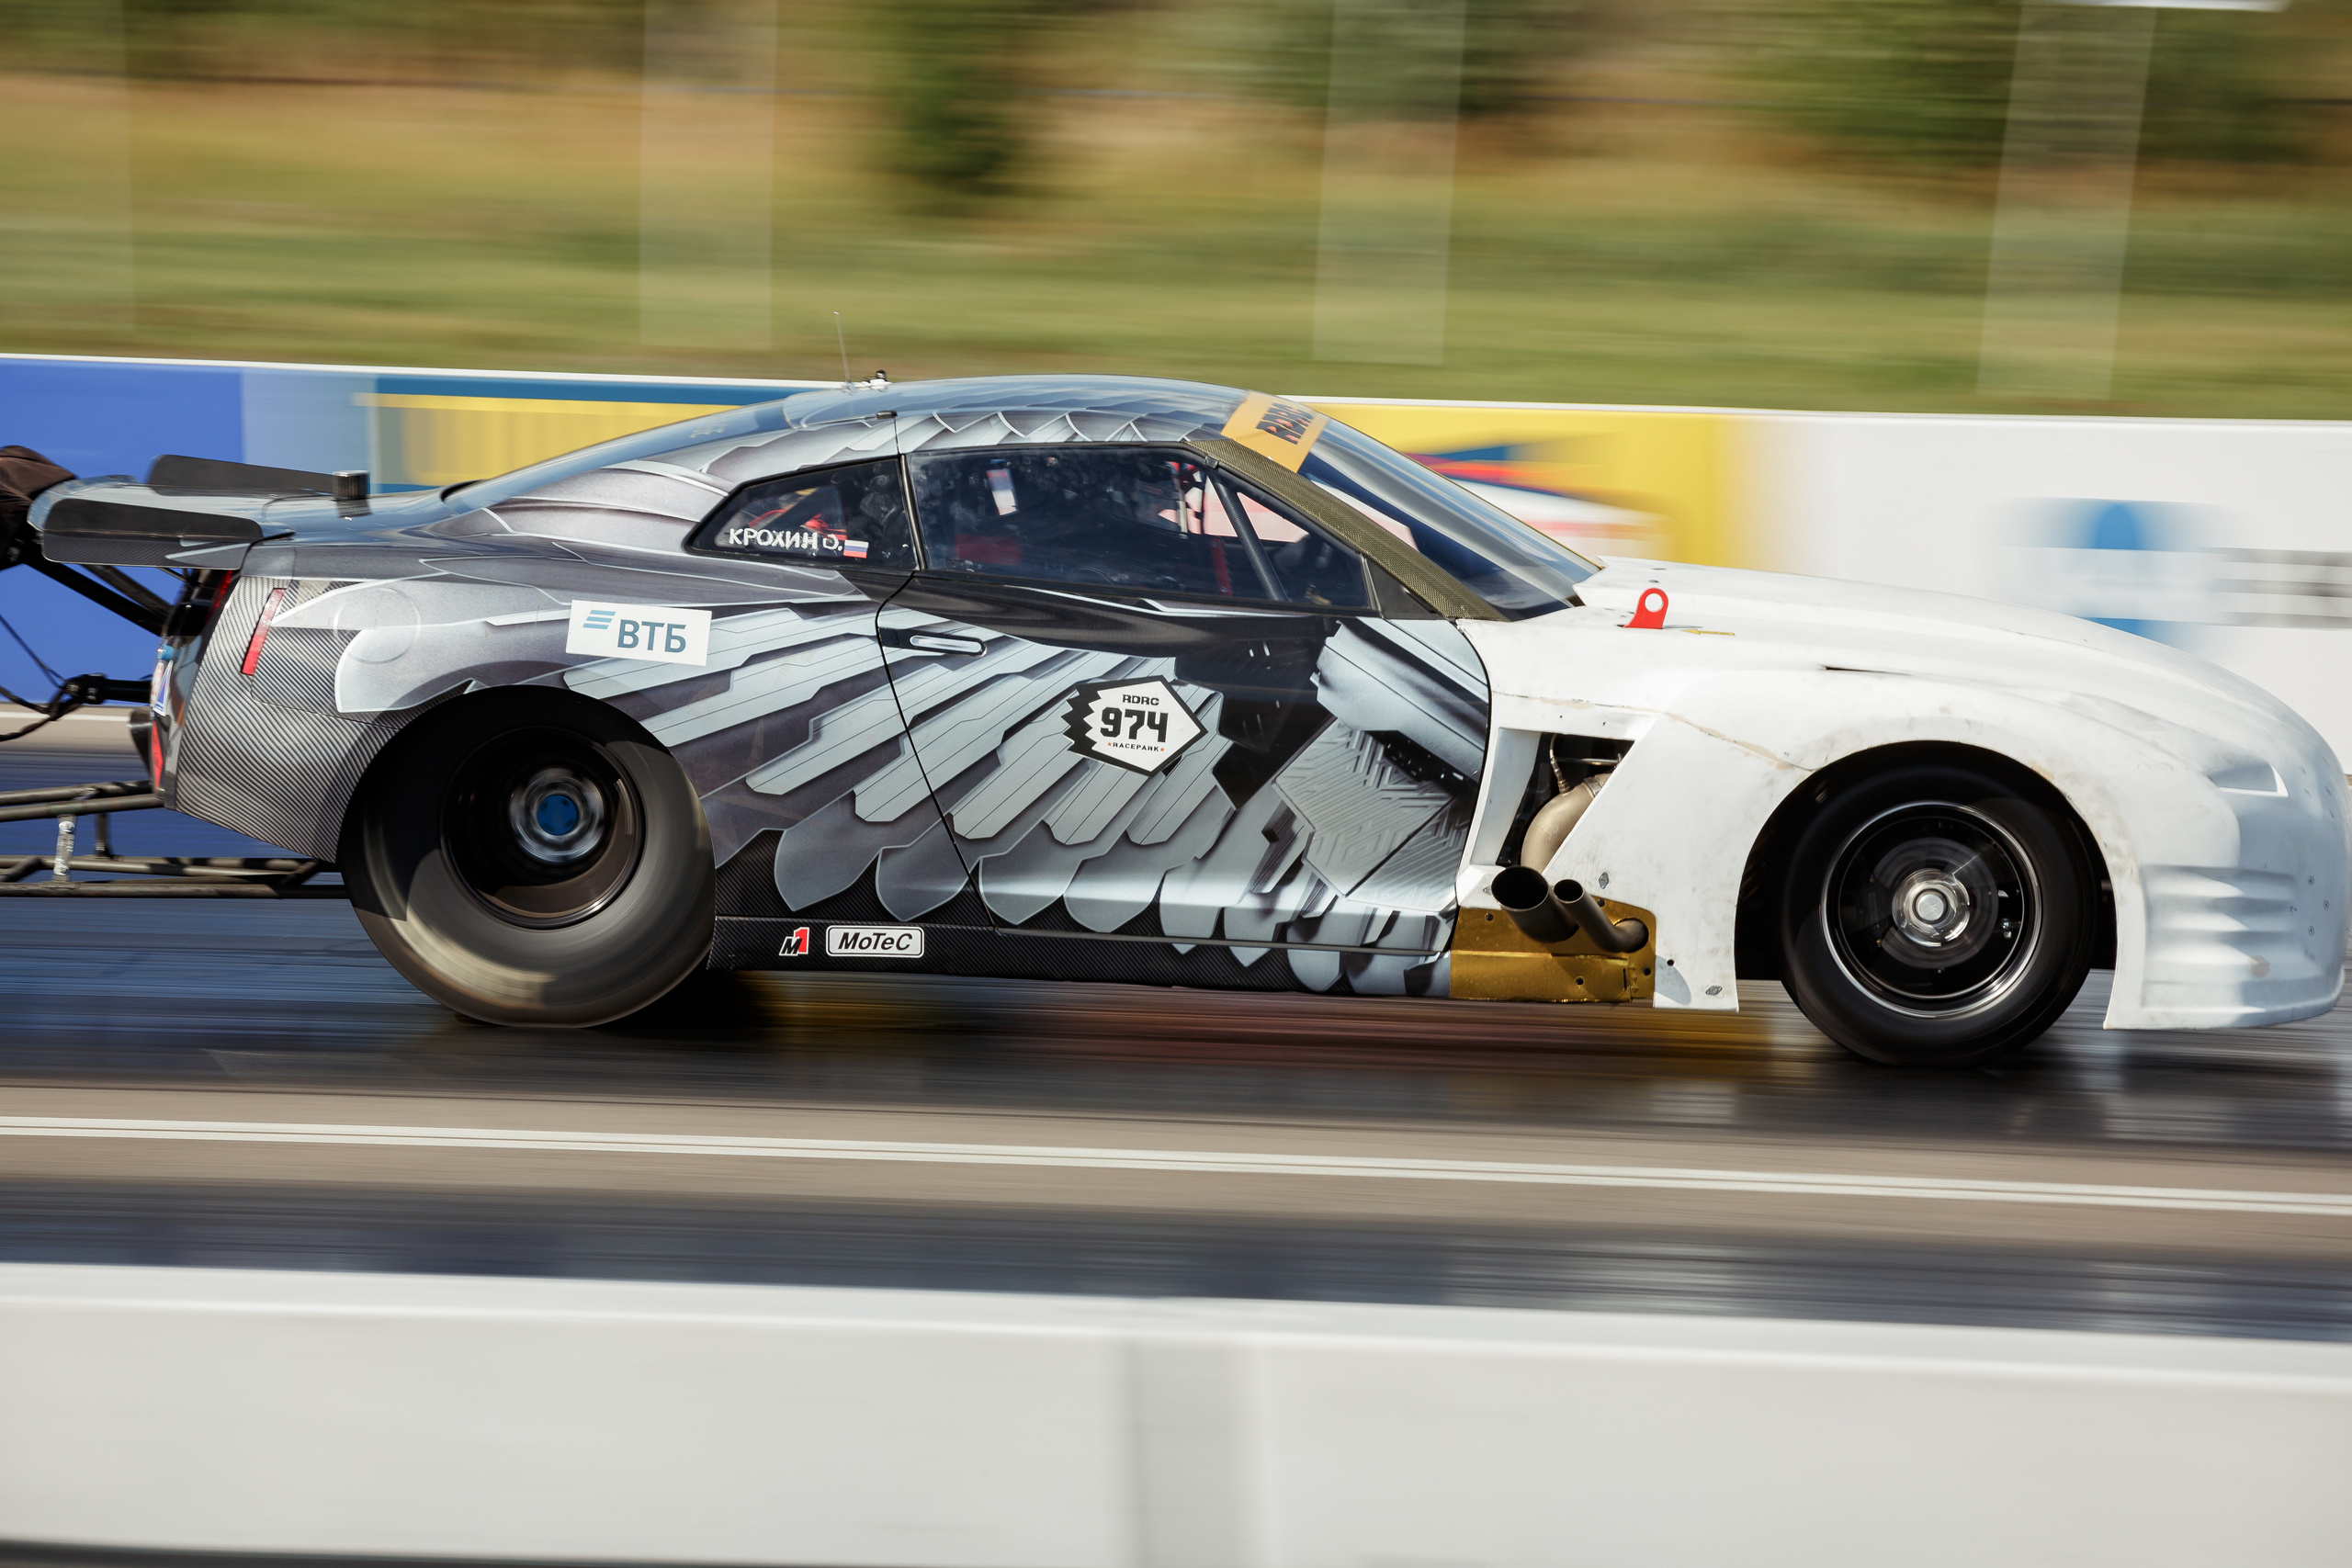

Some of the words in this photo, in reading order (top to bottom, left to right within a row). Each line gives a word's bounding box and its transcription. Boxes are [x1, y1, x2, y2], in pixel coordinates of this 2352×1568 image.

[1255, 402, 1314, 446] RDRC
[729, 528, 818, 549] КРОХИН
[617, 619, 686, 652] ВТБ
[1122, 694, 1159, 705] RDRC
[1101, 706, 1169, 743] 974
[1113, 742, 1159, 751] RACEPARK
[838, 931, 912, 951] MoTeC
